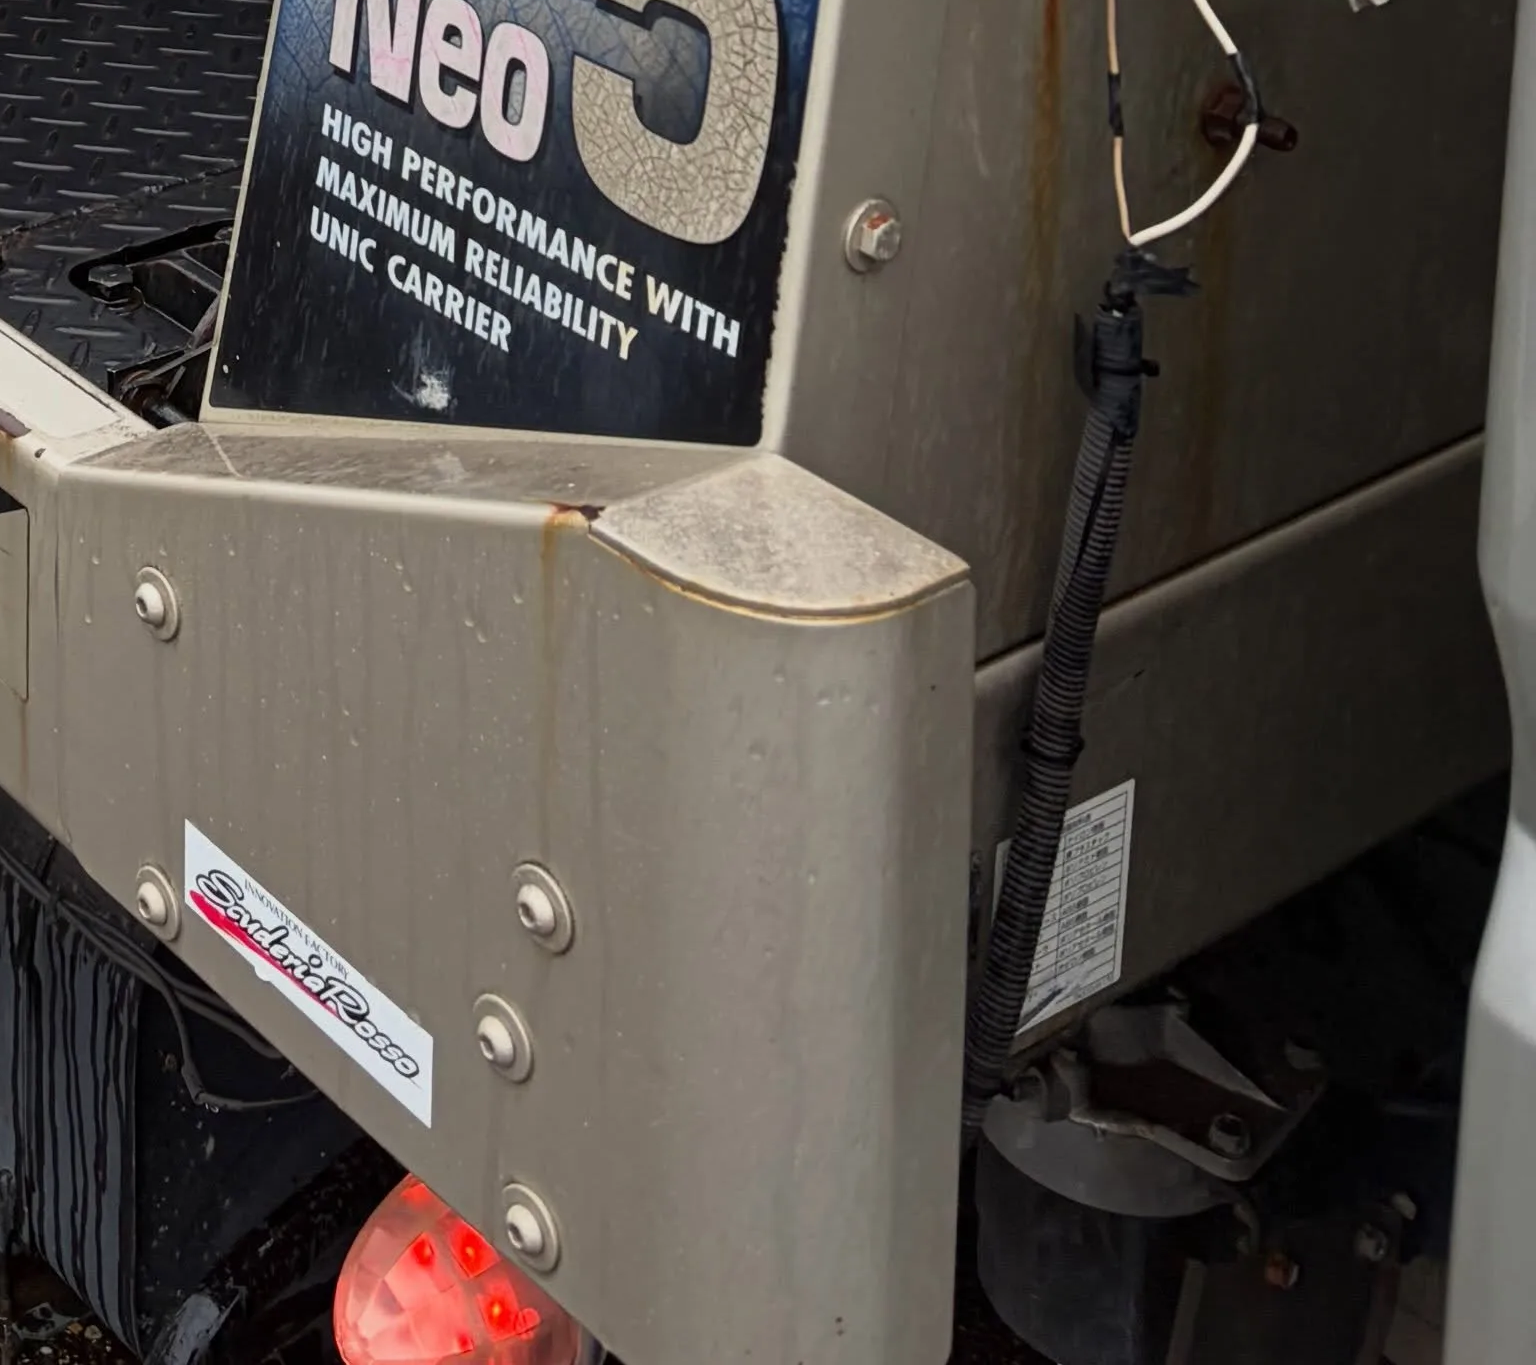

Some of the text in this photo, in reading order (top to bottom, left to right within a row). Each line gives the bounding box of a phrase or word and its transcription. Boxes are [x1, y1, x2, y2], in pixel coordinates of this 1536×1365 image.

[310, 206, 512, 352] UNIC CARRIER
[316, 158, 639, 360] MAXIMUM RELIABILITY
[321, 104, 740, 358] HIGH PERFORMANCE WITH
[244, 877, 350, 981] INNOVATION FACTORY
